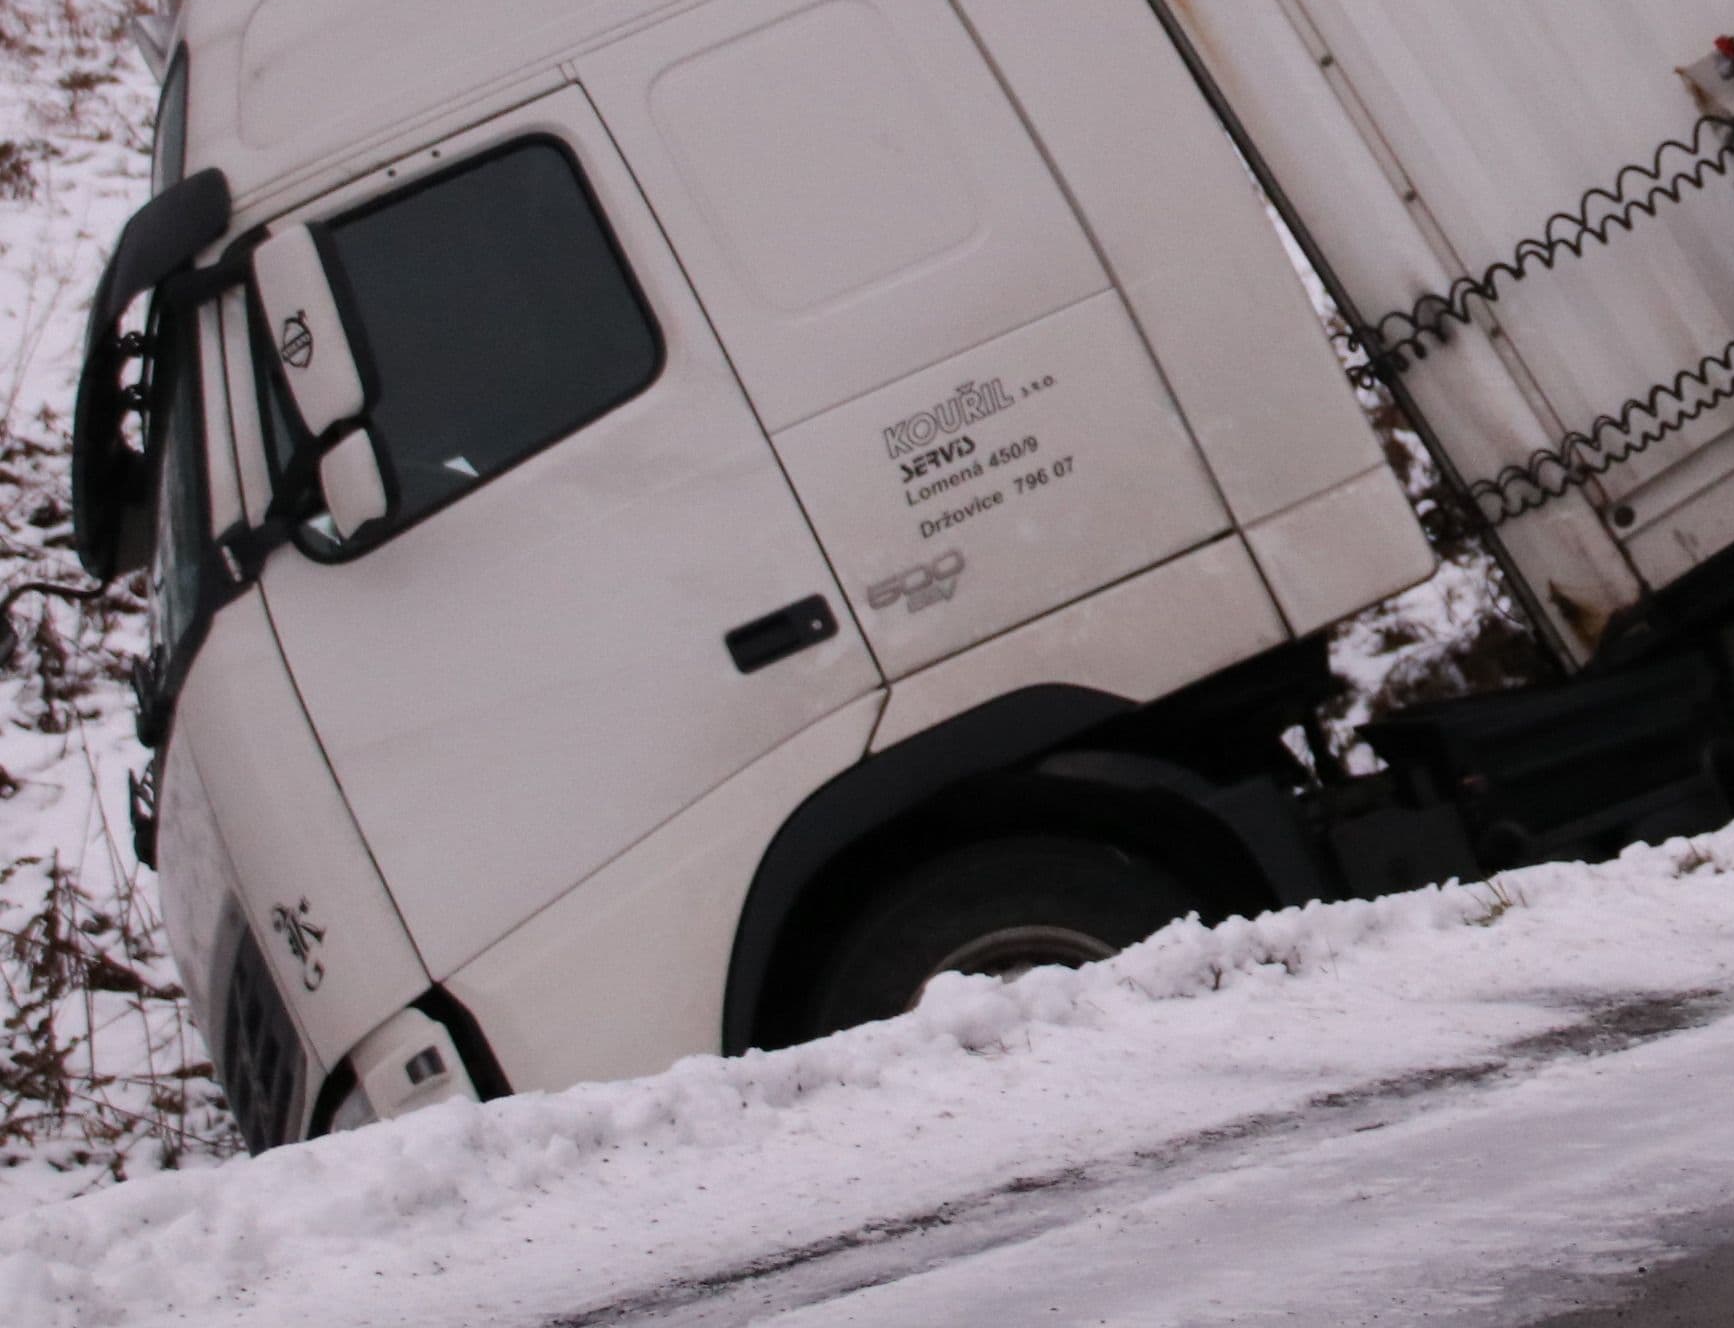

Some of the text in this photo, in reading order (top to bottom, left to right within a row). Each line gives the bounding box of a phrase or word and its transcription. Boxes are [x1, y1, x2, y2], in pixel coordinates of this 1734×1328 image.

[882, 378, 1015, 459] KOUŘIL
[988, 435, 1040, 469] 450/9
[919, 455, 1076, 539] Držovice 796 07
